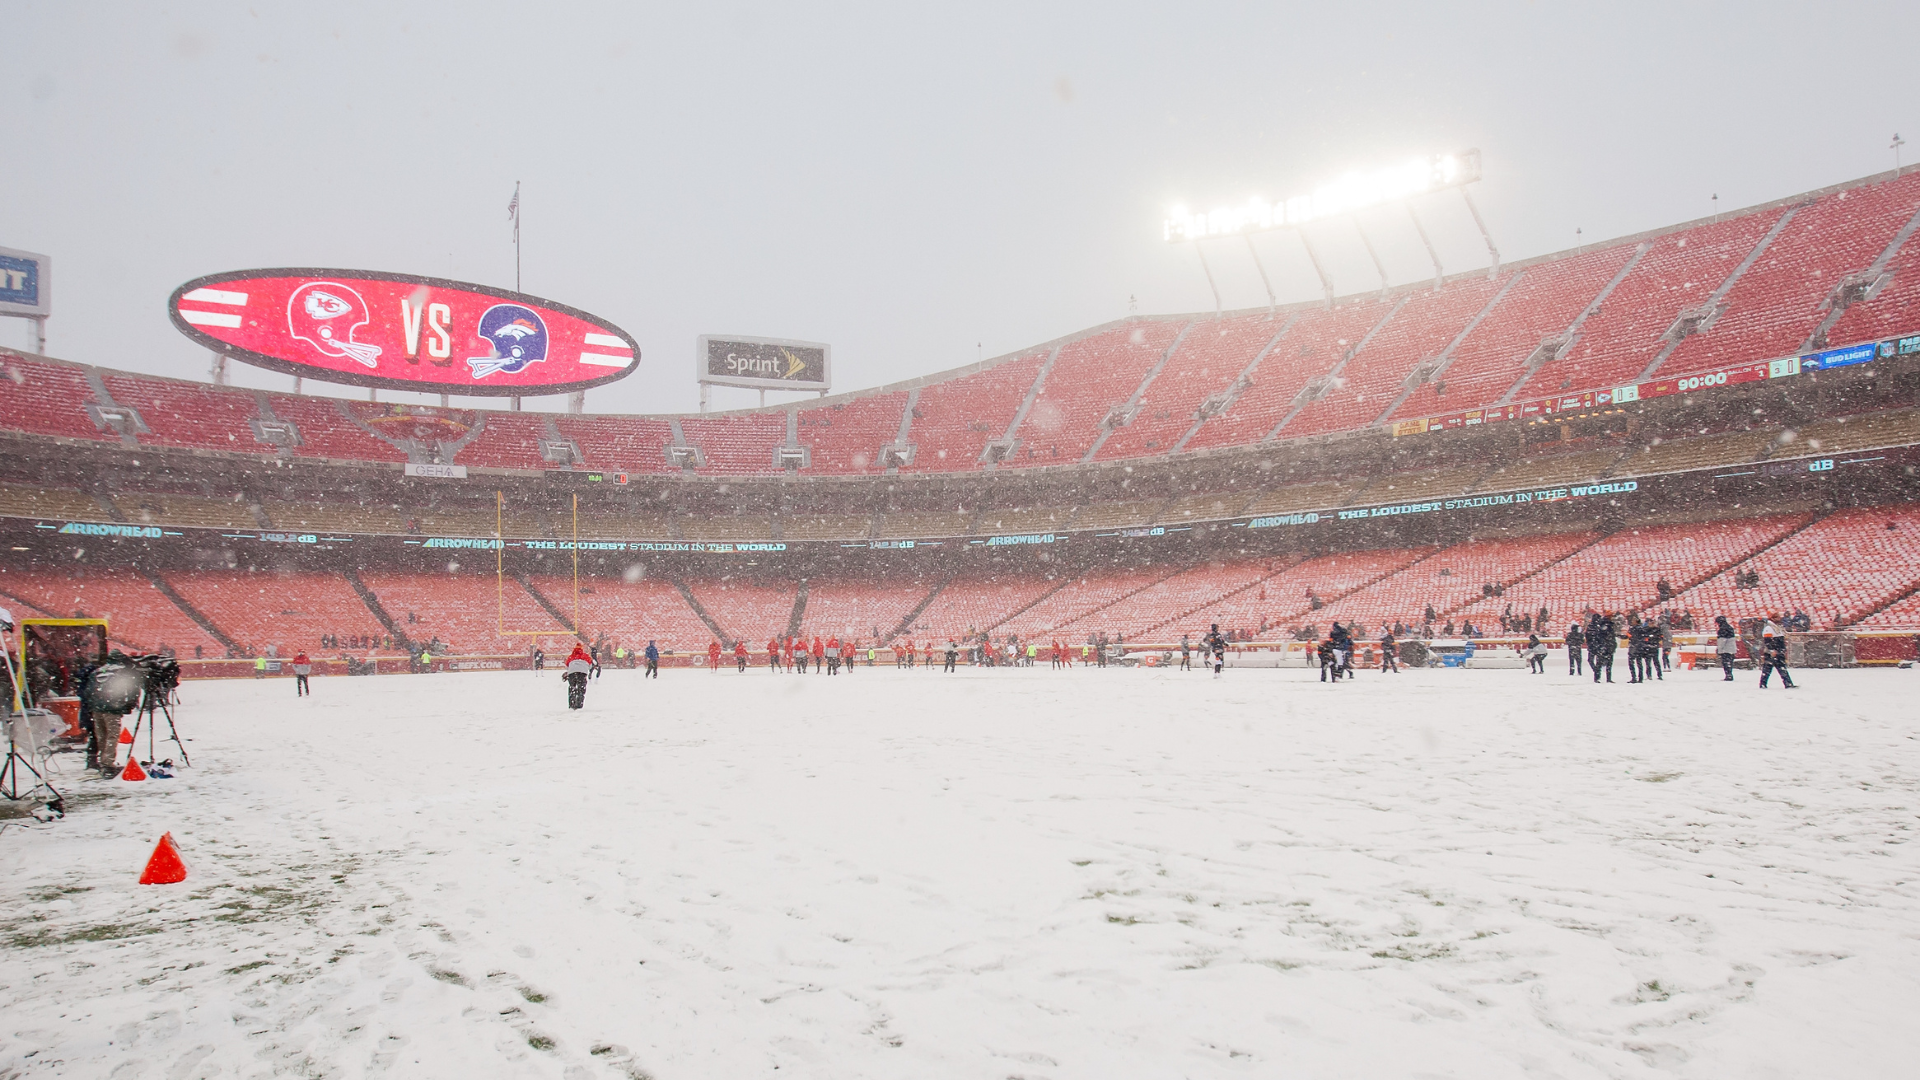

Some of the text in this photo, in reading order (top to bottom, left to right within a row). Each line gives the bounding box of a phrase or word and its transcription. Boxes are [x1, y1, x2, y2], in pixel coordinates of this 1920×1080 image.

[401, 298, 452, 360] VS
[726, 352, 781, 375] Sprint
[1825, 350, 1872, 364] BUD LIGHT
[1678, 372, 1727, 391] 90:00
[415, 465, 454, 477] GEHA
[1248, 481, 1638, 529] ARROWHEAD THE LOUDEST STADIUM IN THE WORLD
[58, 522, 162, 538] ARROWHEAD
[422, 537, 787, 551] ARROWHEAD THE LOUDEST STADIUM IN THE WORLD
[985, 534, 1054, 546] ARROWHEAD
